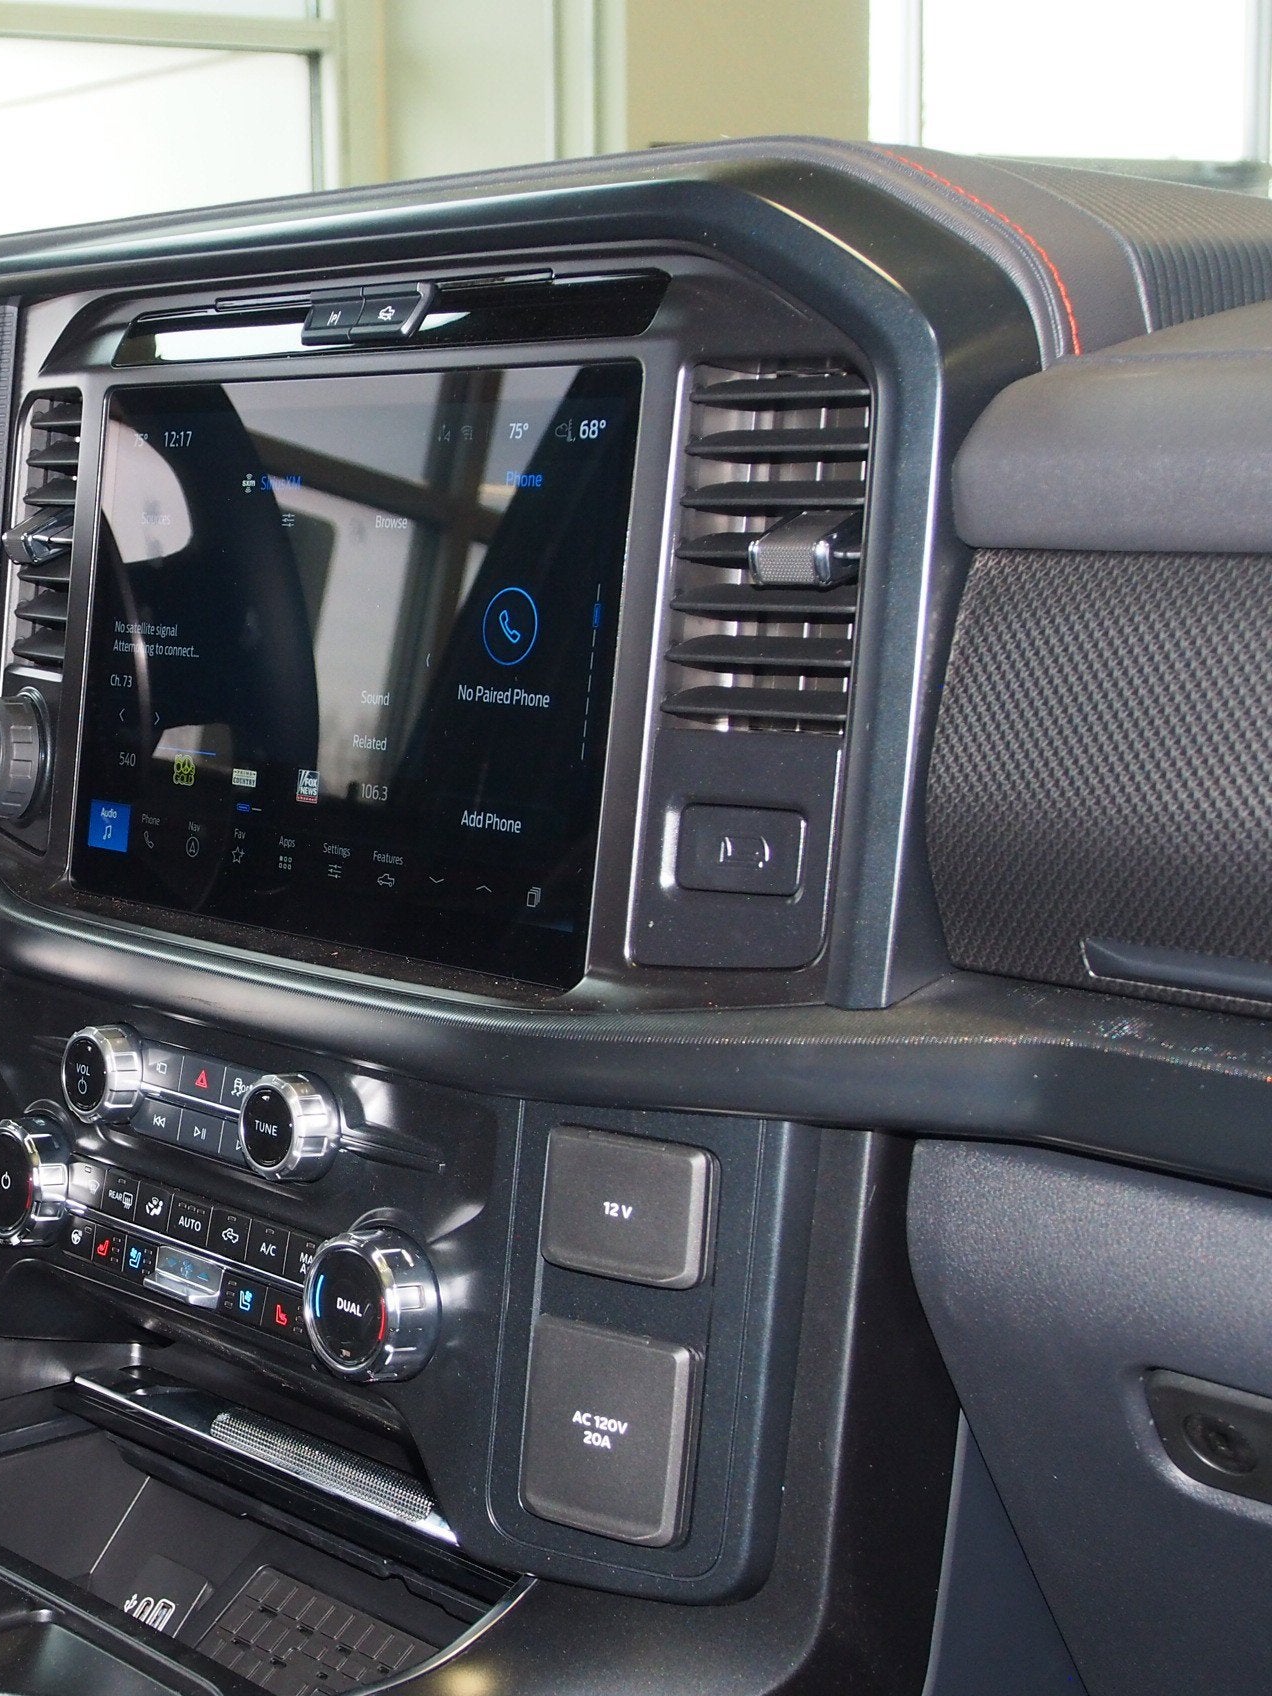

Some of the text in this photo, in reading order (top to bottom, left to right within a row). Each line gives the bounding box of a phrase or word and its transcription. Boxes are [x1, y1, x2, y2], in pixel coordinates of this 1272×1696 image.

[508, 422, 529, 440] 75°
[578, 418, 607, 440] 68°
[163, 430, 193, 448] 12:17
[506, 471, 544, 489] Phone
[375, 514, 408, 530] Browse
[114, 620, 178, 638] No satellite signal
[155, 642, 163, 655] to
[110, 674, 133, 688] Ch. 73
[360, 690, 390, 706] Sound
[457, 683, 550, 708] No Paired Phone
[352, 734, 387, 751] Related
[118, 752, 136, 768] 540
[304, 777, 318, 788] FOX
[299, 786, 318, 796] NEWS
[360, 782, 388, 801] 106.3
[100, 807, 118, 819] Audio
[141, 813, 160, 826] Phone
[188, 820, 201, 833] Nav
[461, 810, 522, 834] Add Phone
[234, 828, 246, 840] Fav
[278, 836, 296, 848] Apps
[322, 842, 351, 858] Settings
[372, 850, 404, 866] Features
[76, 1063, 91, 1077] VOL
[254, 1119, 278, 1136] TUNE
[108, 1189, 123, 1201] REAR
[603, 1201, 633, 1219] 12 V
[178, 1215, 202, 1232] AUTO
[260, 1242, 277, 1257] A/C
[299, 1252, 313, 1265] MA
[336, 1297, 363, 1318] DUAL
[571, 1410, 628, 1435] AC 120V
[582, 1430, 612, 1450] 20A
